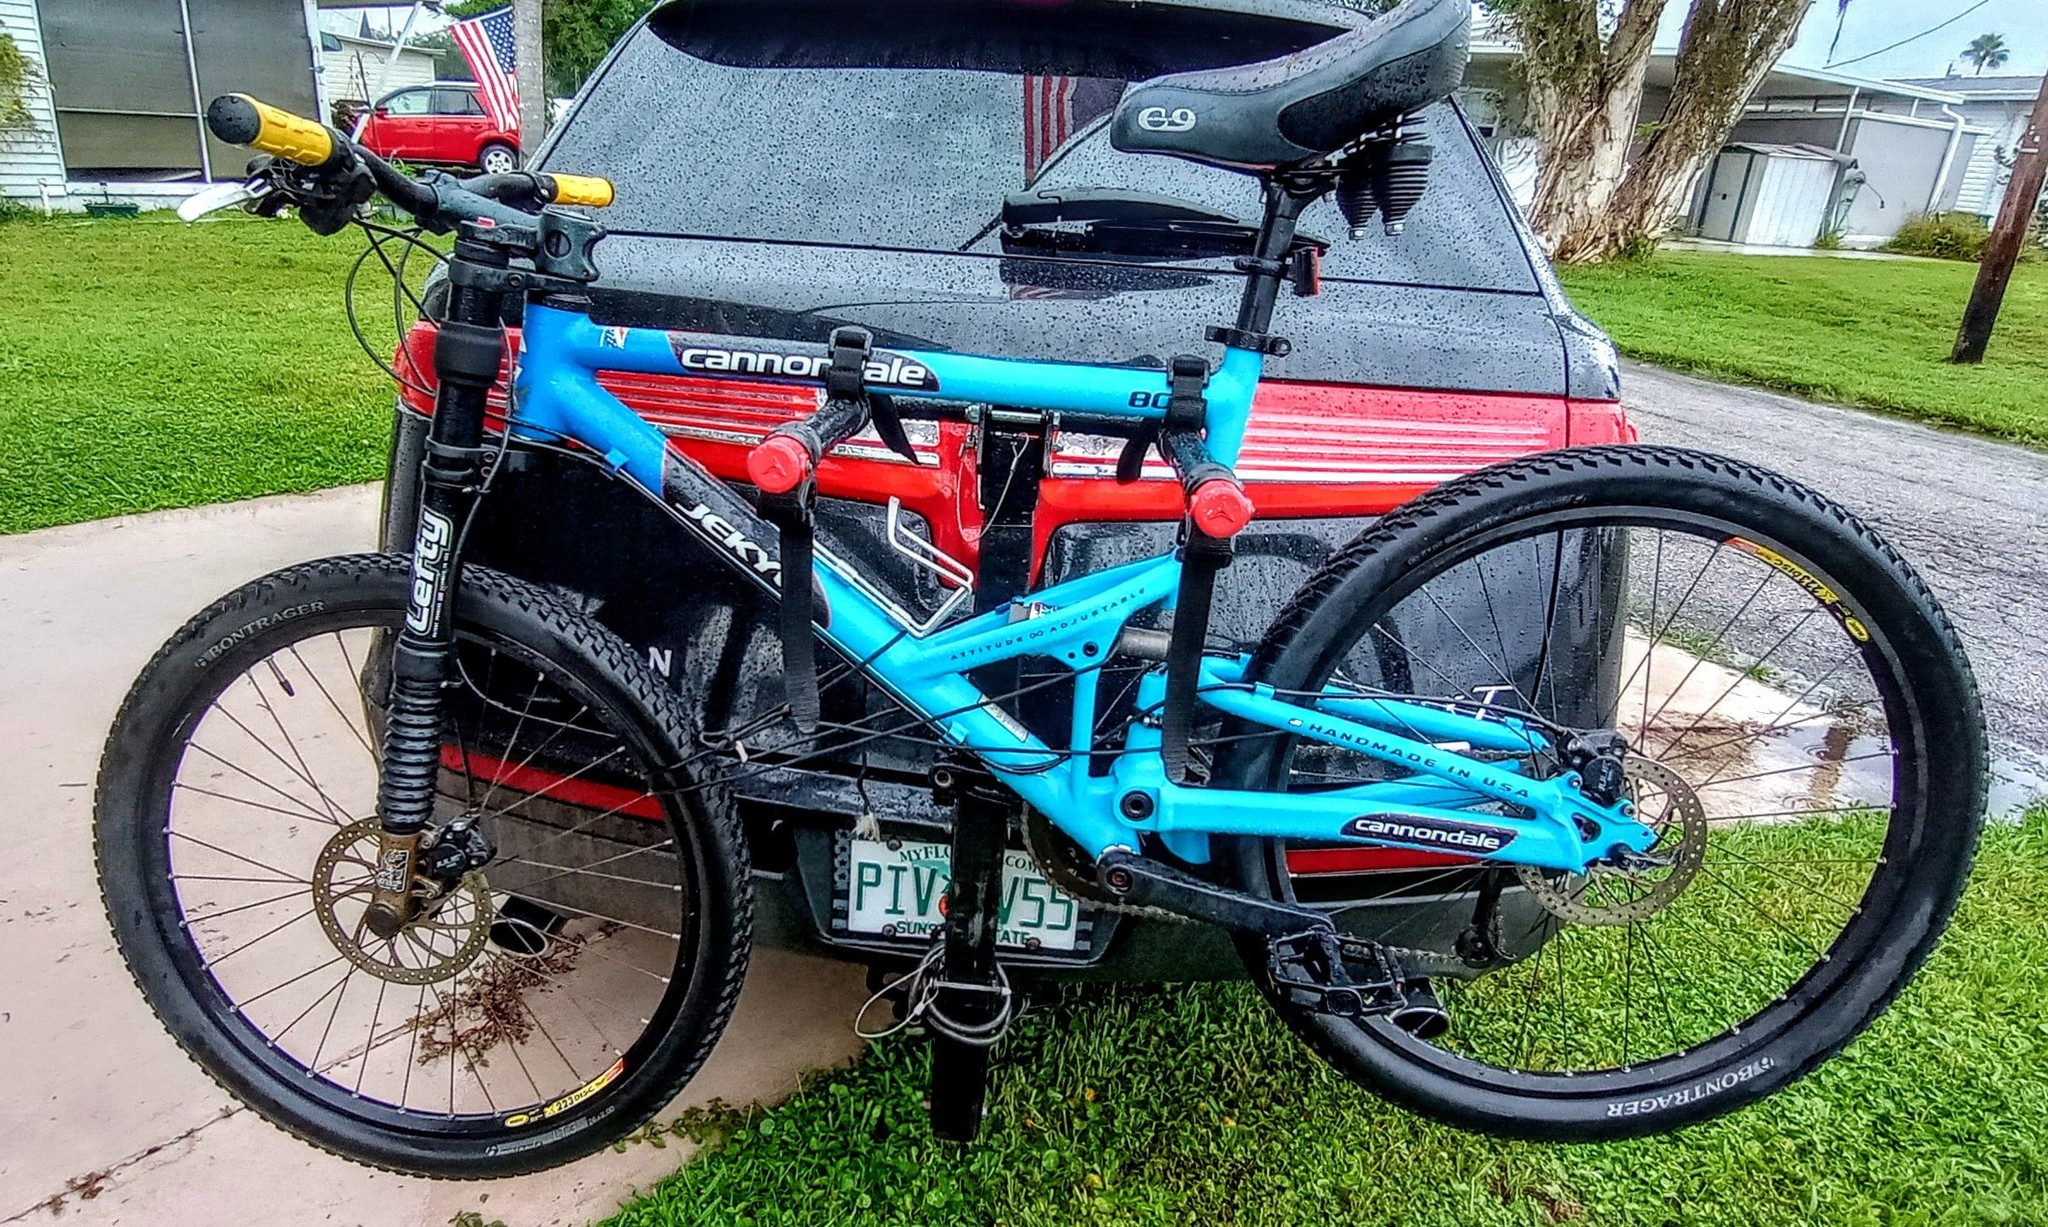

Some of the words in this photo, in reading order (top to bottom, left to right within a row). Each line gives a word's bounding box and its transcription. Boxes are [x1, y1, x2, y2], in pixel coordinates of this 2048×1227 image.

[682, 349, 927, 386] cannonale
[406, 509, 450, 632] Lefty
[675, 502, 782, 587] JEKY
[207, 601, 325, 659] BONTRAGER
[951, 635, 1024, 662] ATTITUDE
[1049, 588, 1146, 633] ADJUSTABLE
[1309, 723, 1438, 769] HANDMADE
[1447, 765, 1471, 779] IN
[1482, 778, 1530, 799] USA
[1355, 819, 1500, 850] cannondale
[856, 861, 938, 916] PIV
[896, 920, 937, 936] SUNS
[998, 926, 1031, 946] ATE
[1607, 1064, 1753, 1117] BONTRAGER
